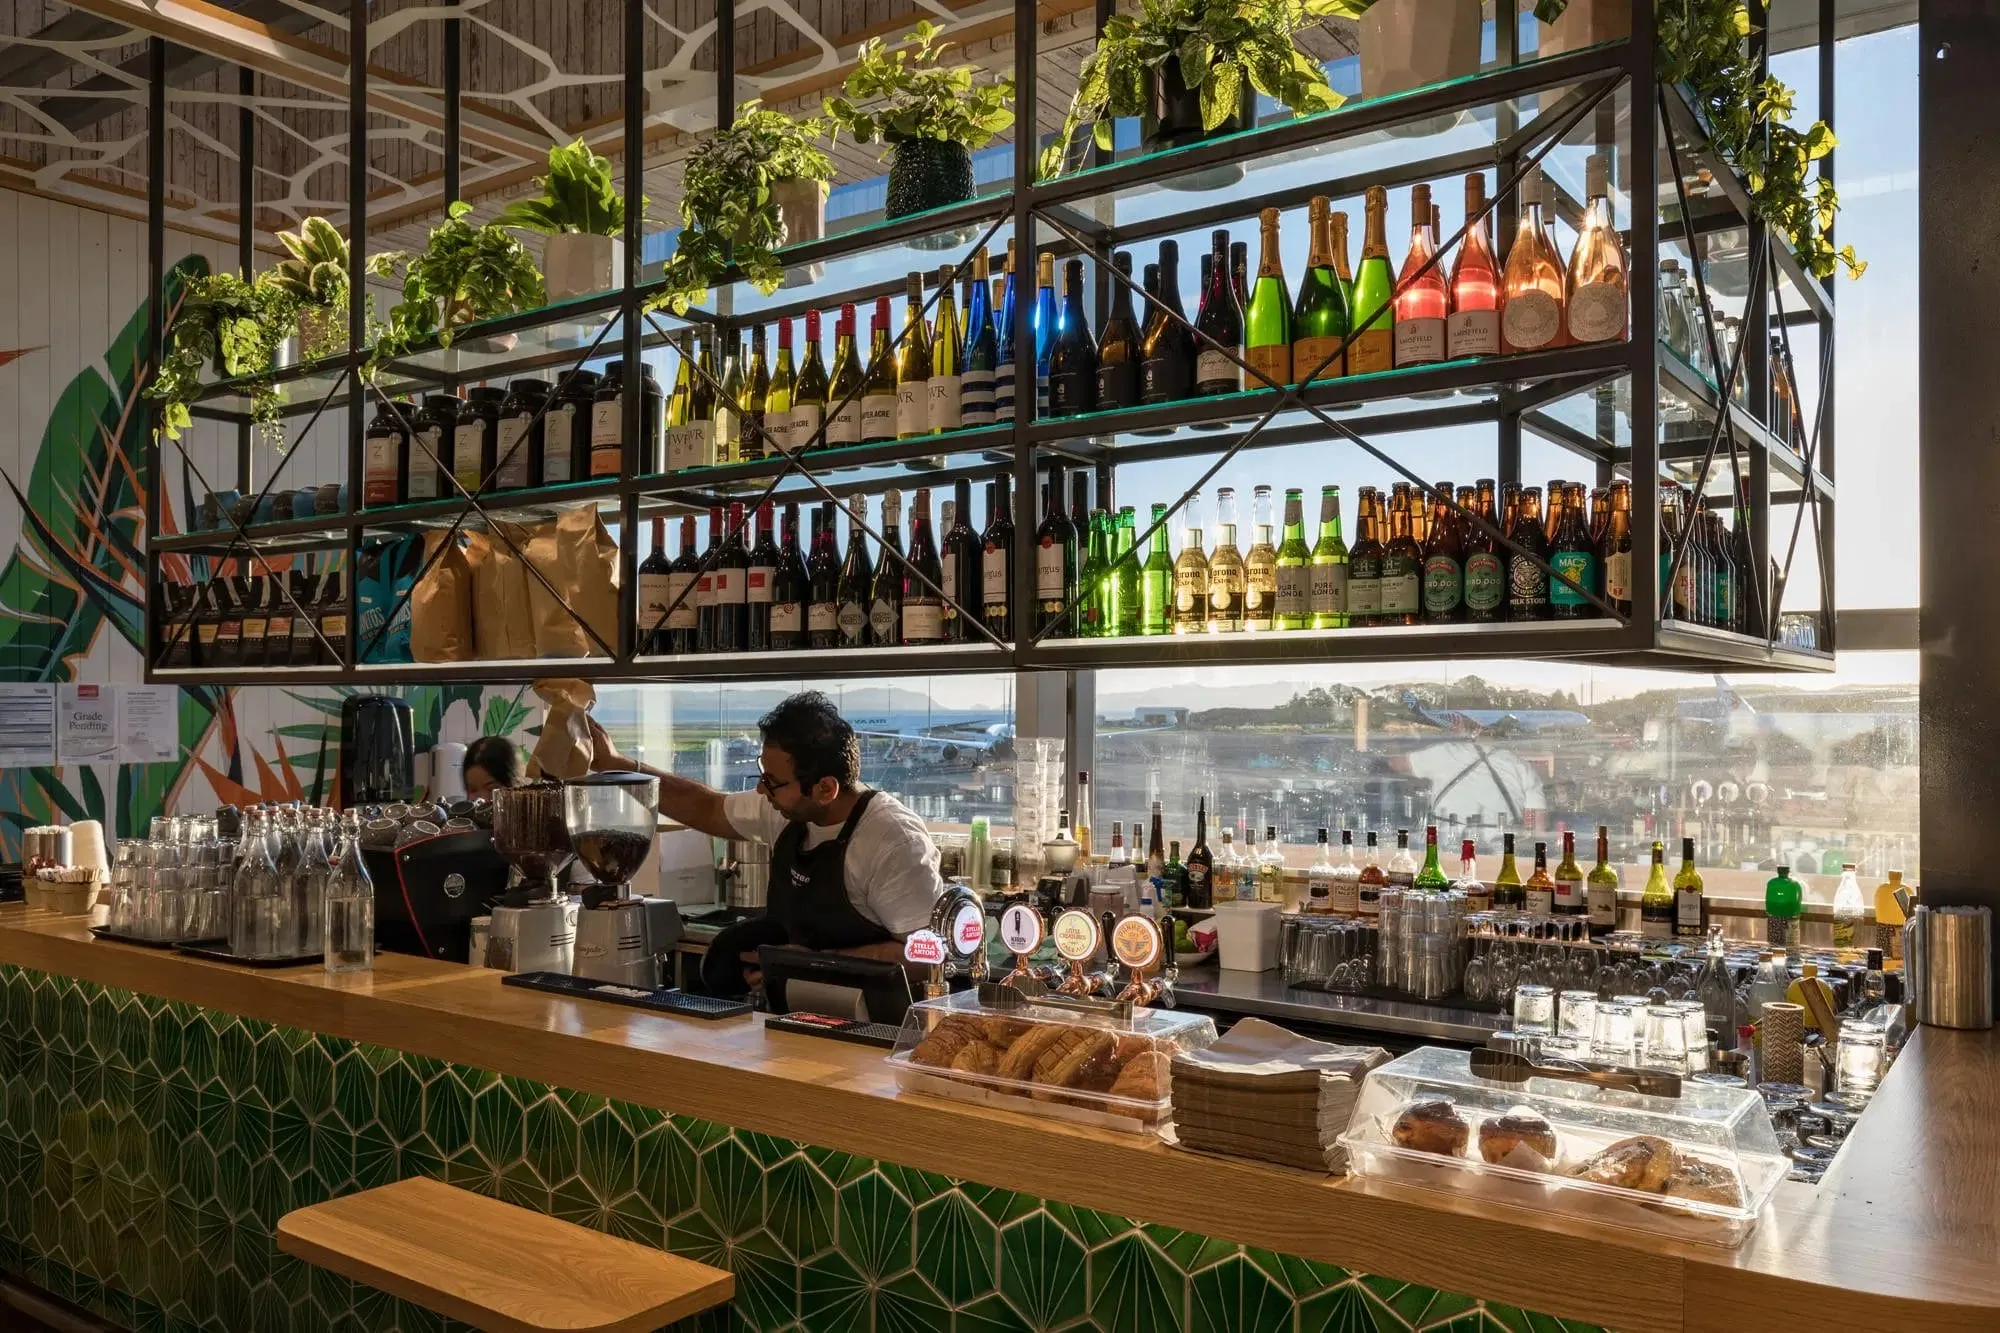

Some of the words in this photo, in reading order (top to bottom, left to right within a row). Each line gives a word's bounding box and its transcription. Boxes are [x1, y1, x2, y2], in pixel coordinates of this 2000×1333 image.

[1277, 590, 1304, 598] LONDE
[73, 712, 103, 721] Grade
[68, 721, 108, 732] Pending
[914, 943, 935, 951] STELLA
[913, 949, 936, 957] ARTOIS
